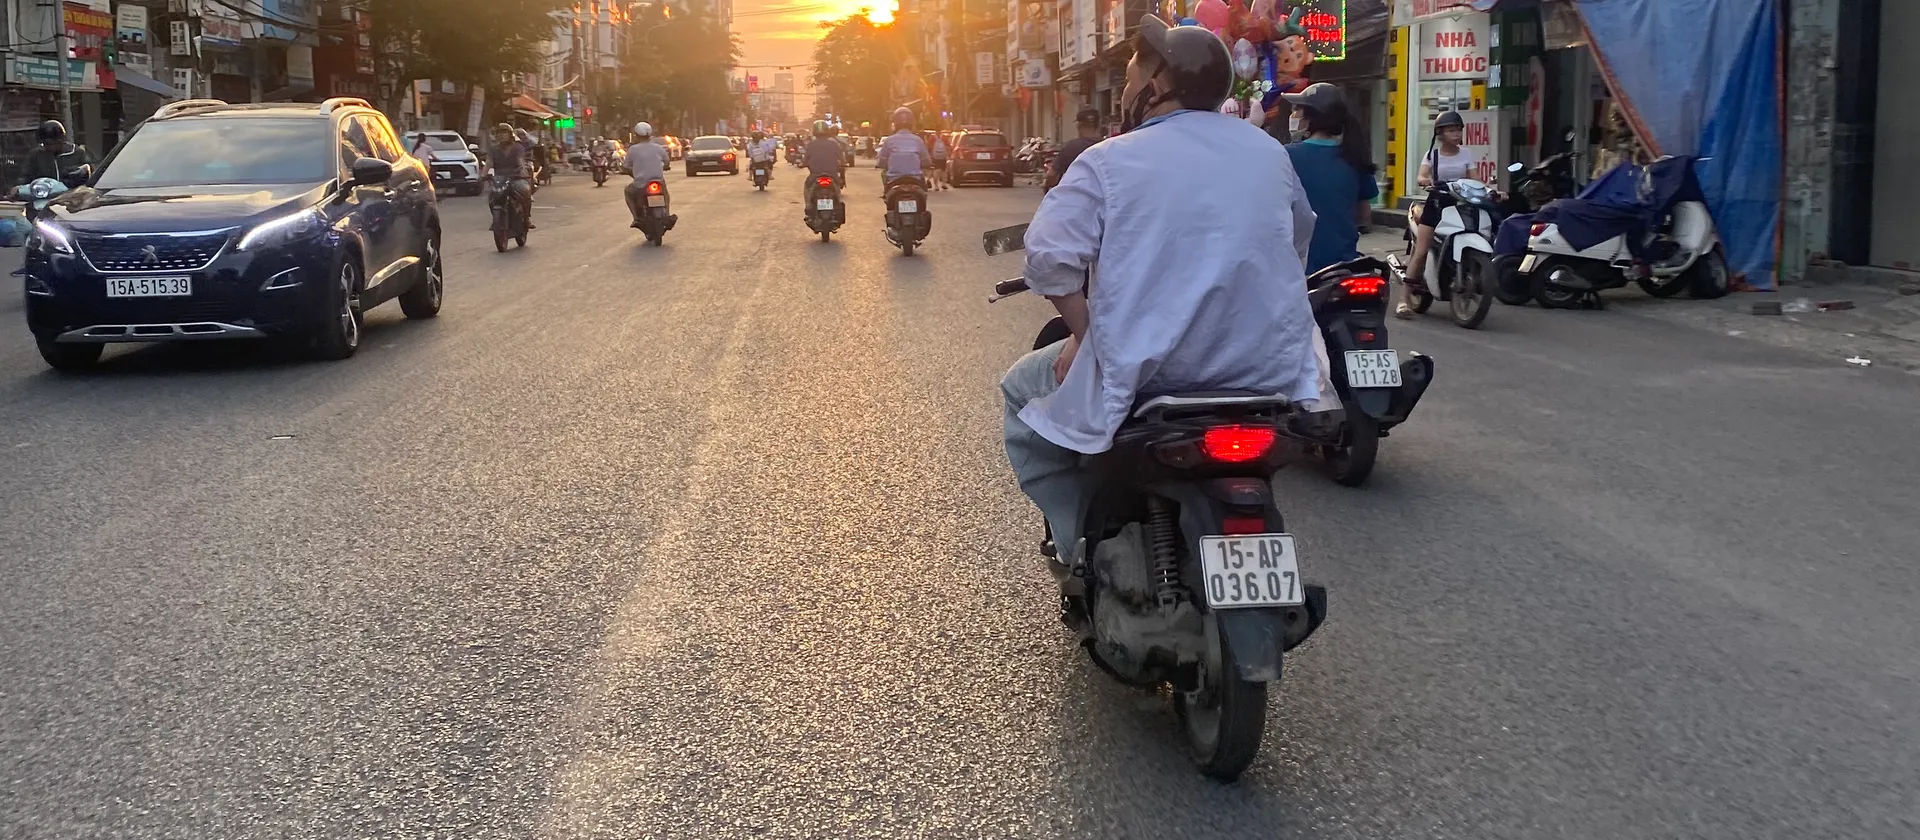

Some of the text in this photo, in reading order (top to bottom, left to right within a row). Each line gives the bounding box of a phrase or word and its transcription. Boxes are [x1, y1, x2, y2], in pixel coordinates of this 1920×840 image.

[1435, 28, 1477, 48] NHÀ
[1423, 51, 1488, 74] THUỐC
[1465, 117, 1491, 145] NHÀ
[111, 279, 188, 295] 15A-515.39
[1354, 353, 1391, 368] 15-AS
[1352, 369, 1398, 385] 111.28
[1217, 539, 1283, 570] 15-AP
[1210, 571, 1295, 603] 036.07
